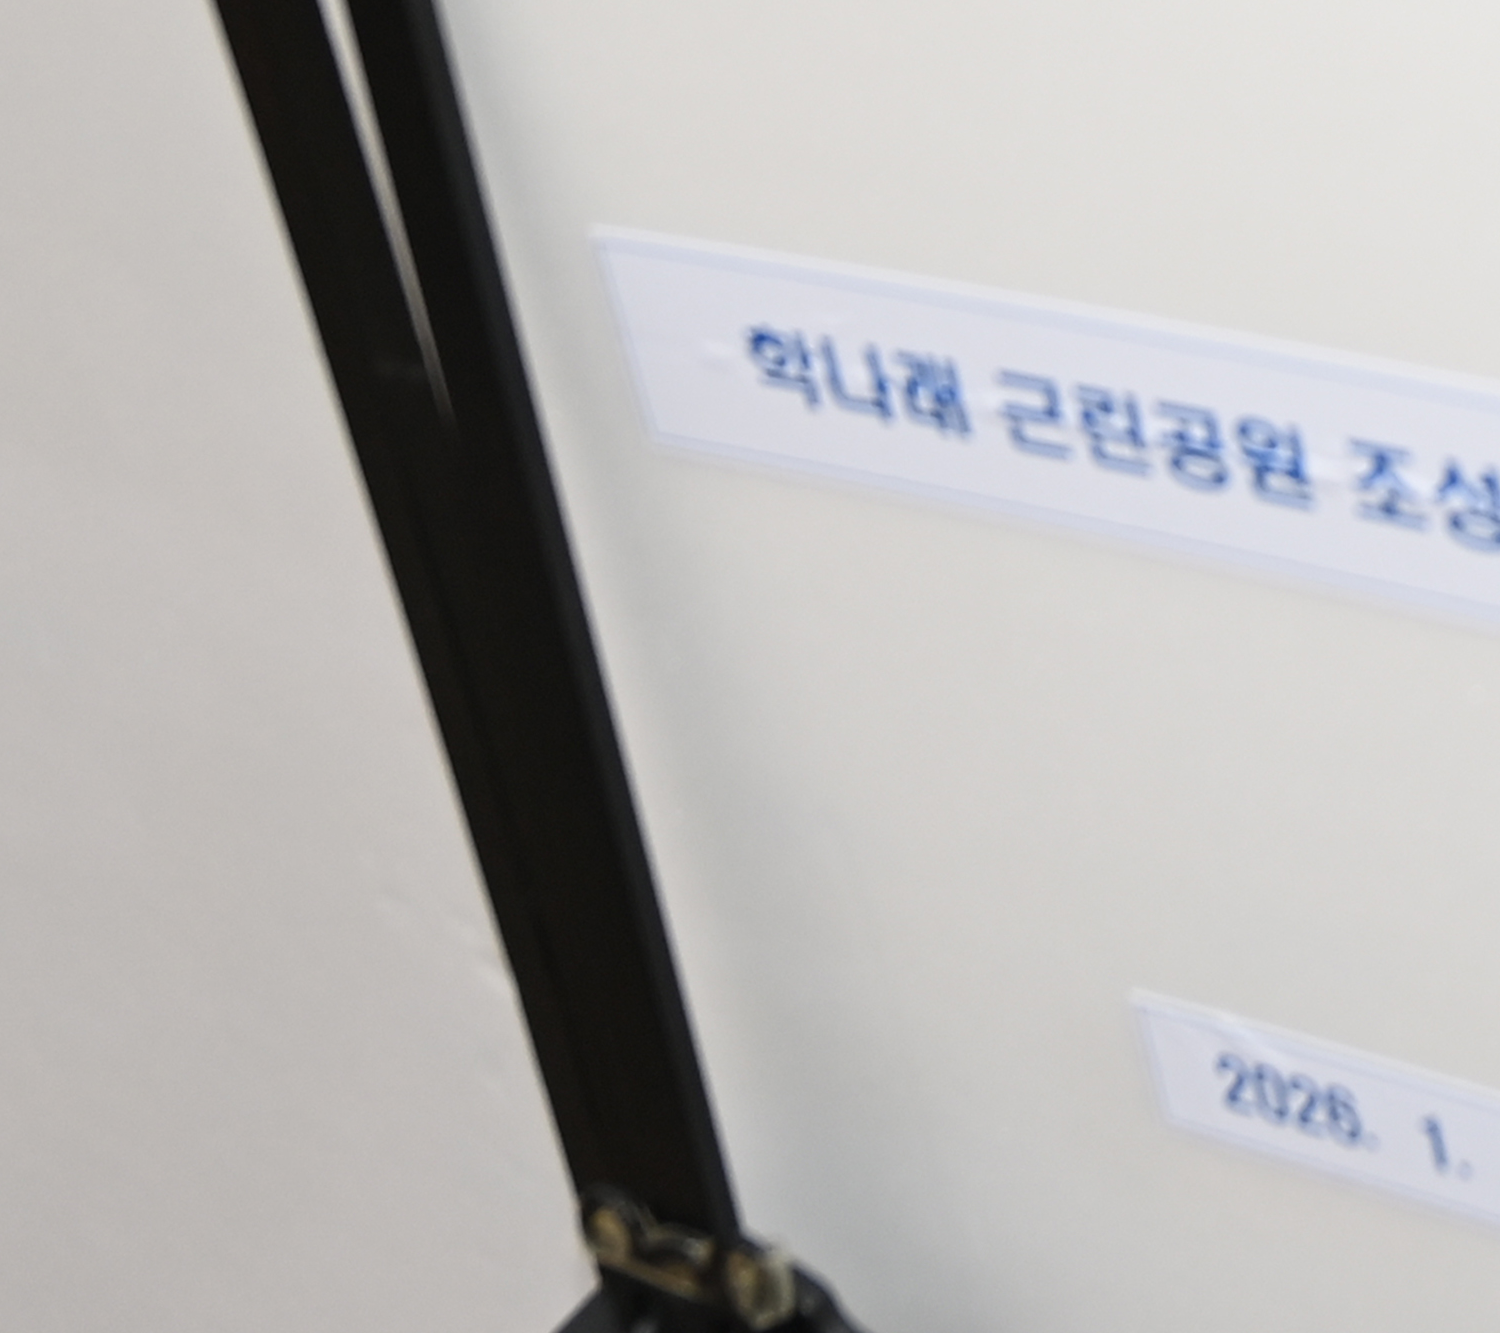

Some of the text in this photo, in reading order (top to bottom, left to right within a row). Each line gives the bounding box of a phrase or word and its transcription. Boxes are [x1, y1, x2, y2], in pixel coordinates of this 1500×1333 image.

[746, 324, 974, 444] 학나래
[996, 367, 1314, 511] 근린공원
[1215, 1051, 1474, 1180] 2026. 1.
